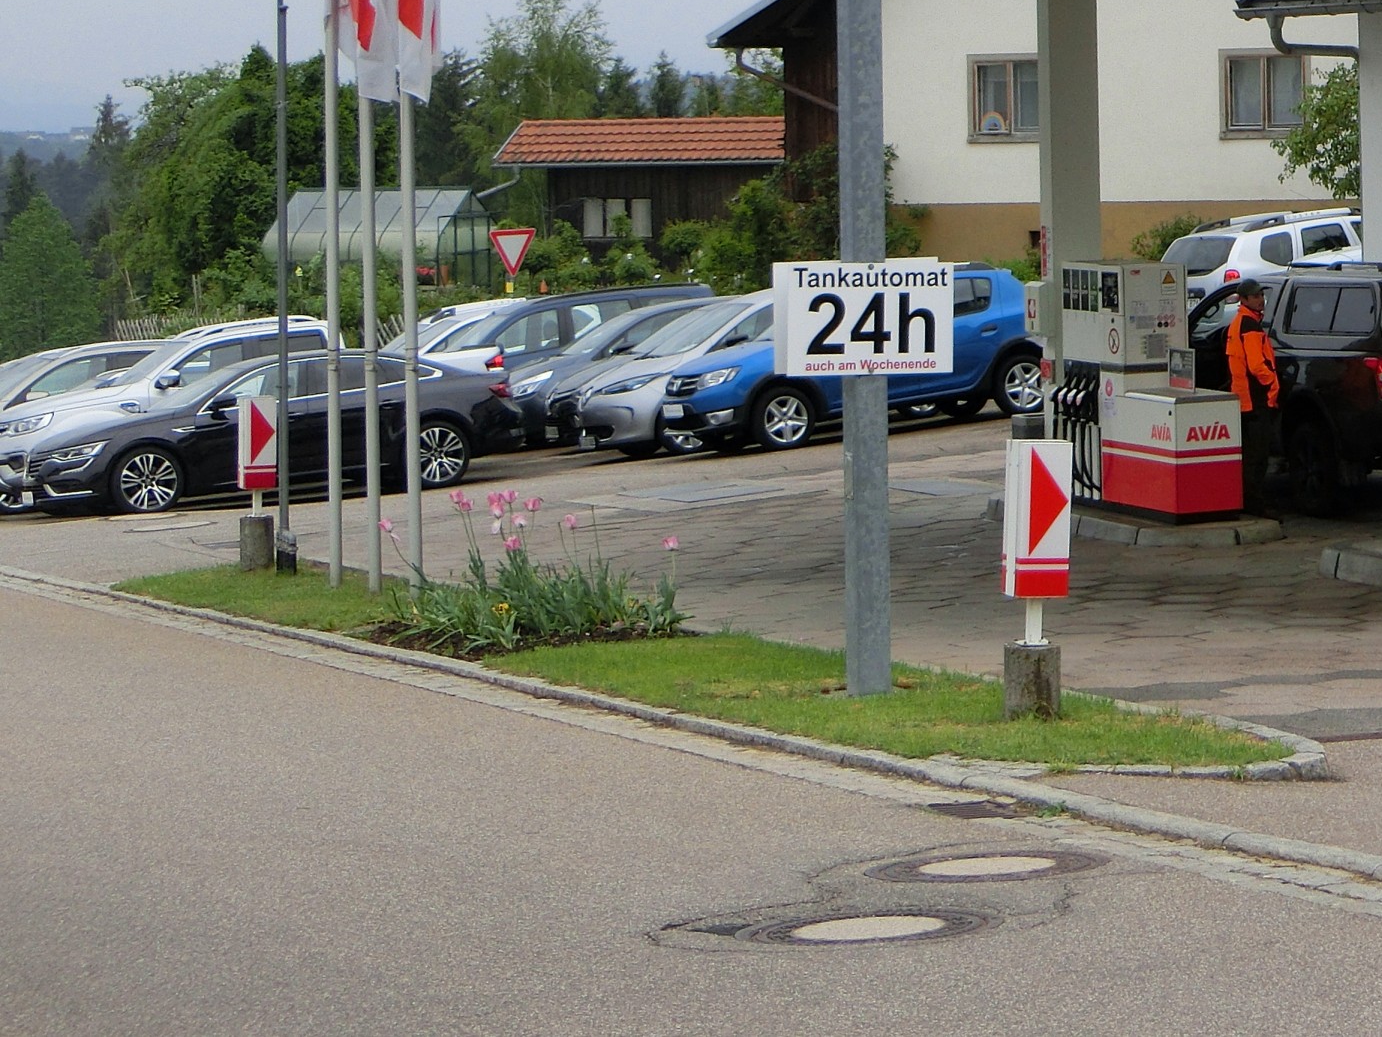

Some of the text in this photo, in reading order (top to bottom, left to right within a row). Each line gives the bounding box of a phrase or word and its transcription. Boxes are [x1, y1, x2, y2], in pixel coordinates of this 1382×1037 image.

[793, 267, 948, 288] Tankautomat
[806, 292, 936, 355] 24h
[805, 359, 936, 372] auch am Wochenende
